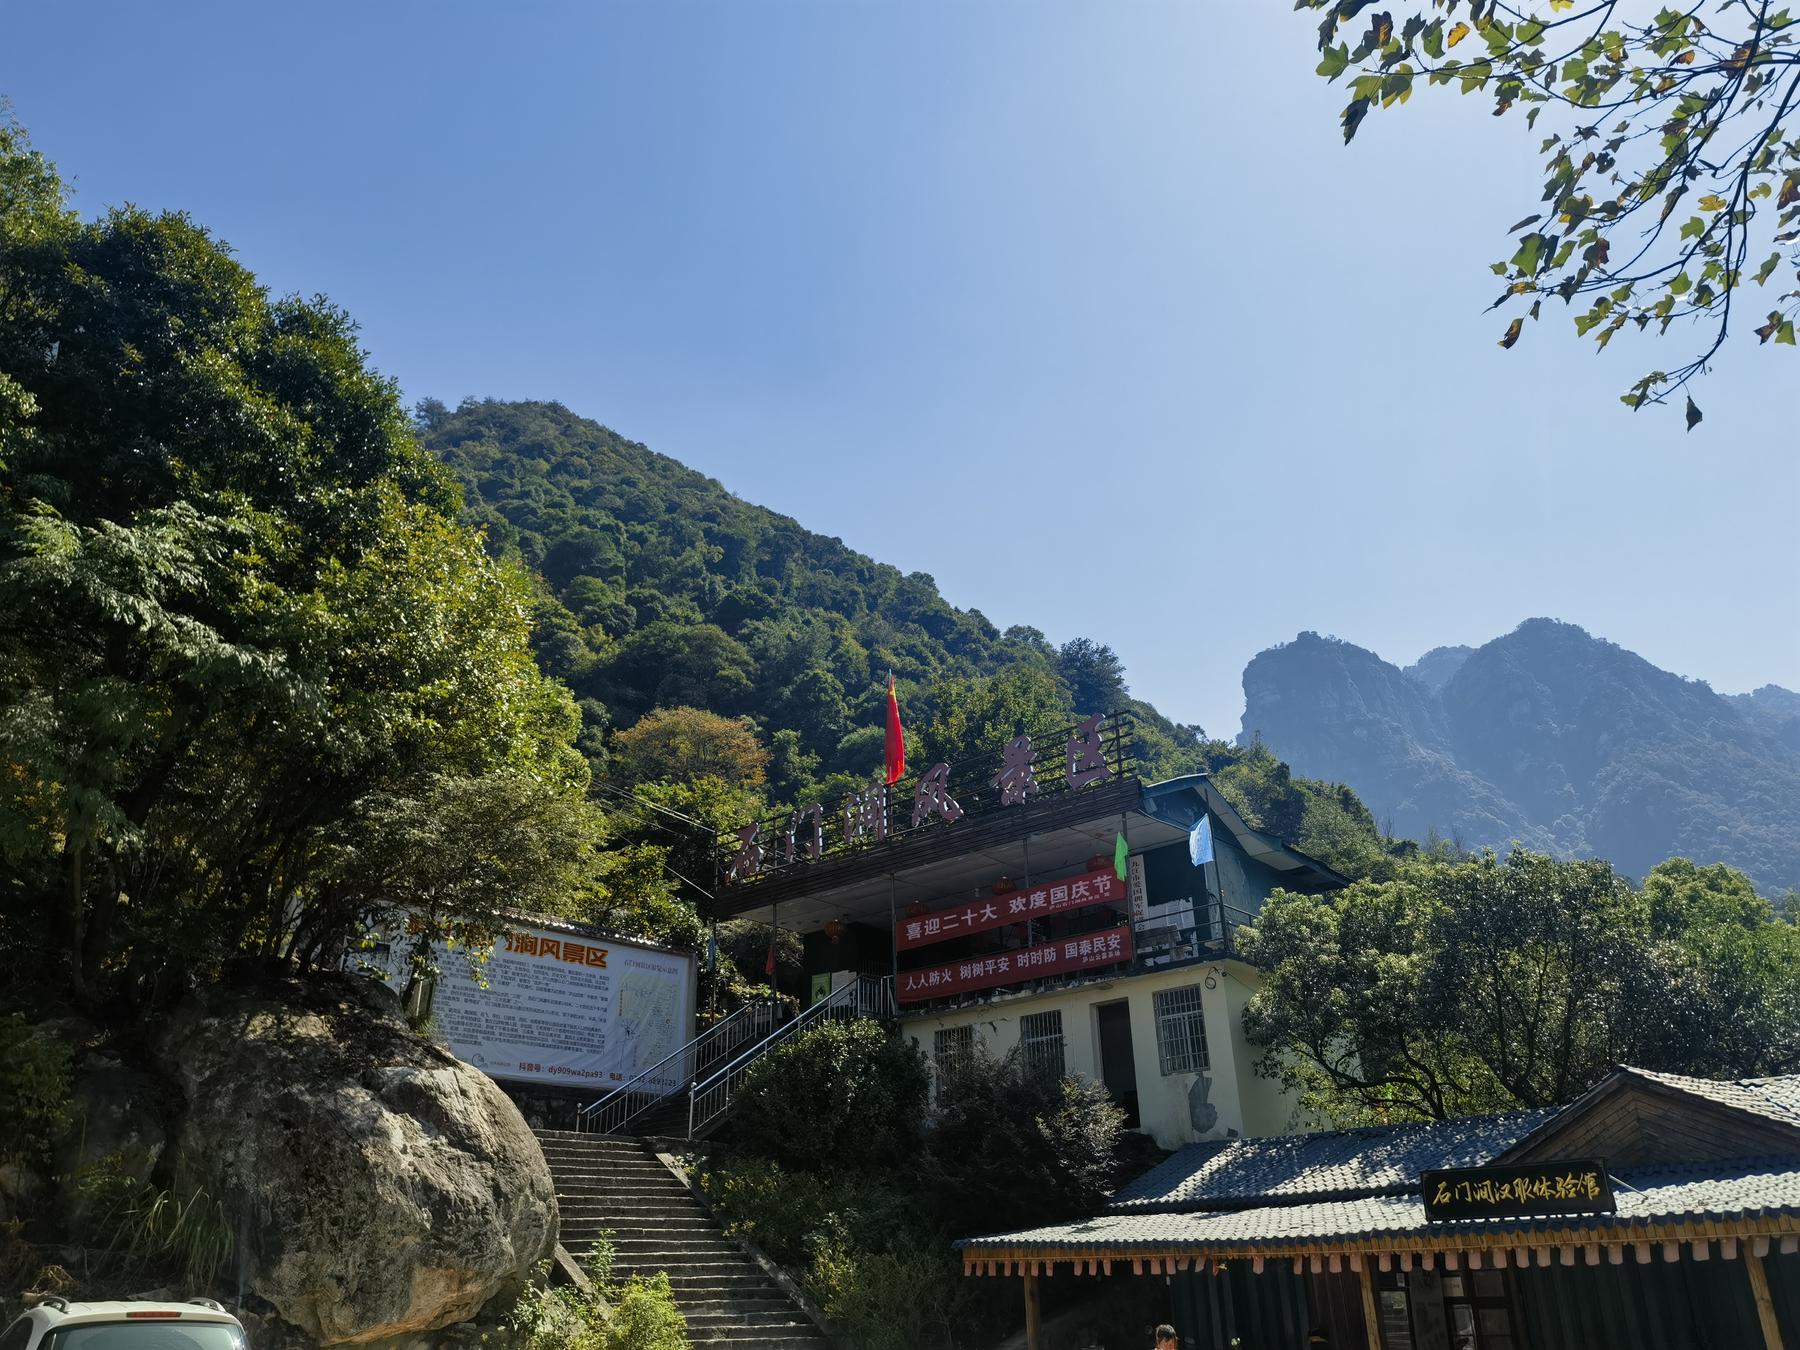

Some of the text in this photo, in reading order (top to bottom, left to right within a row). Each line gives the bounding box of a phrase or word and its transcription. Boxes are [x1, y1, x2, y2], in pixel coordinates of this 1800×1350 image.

[905, 874, 1113, 941] 喜迎二十大 欢度国庆节
[905, 933, 1121, 992] 人人防火 树树平安 时时防 国泰民安
[1431, 1171, 1601, 1206] 石门涧汉服体验馆
